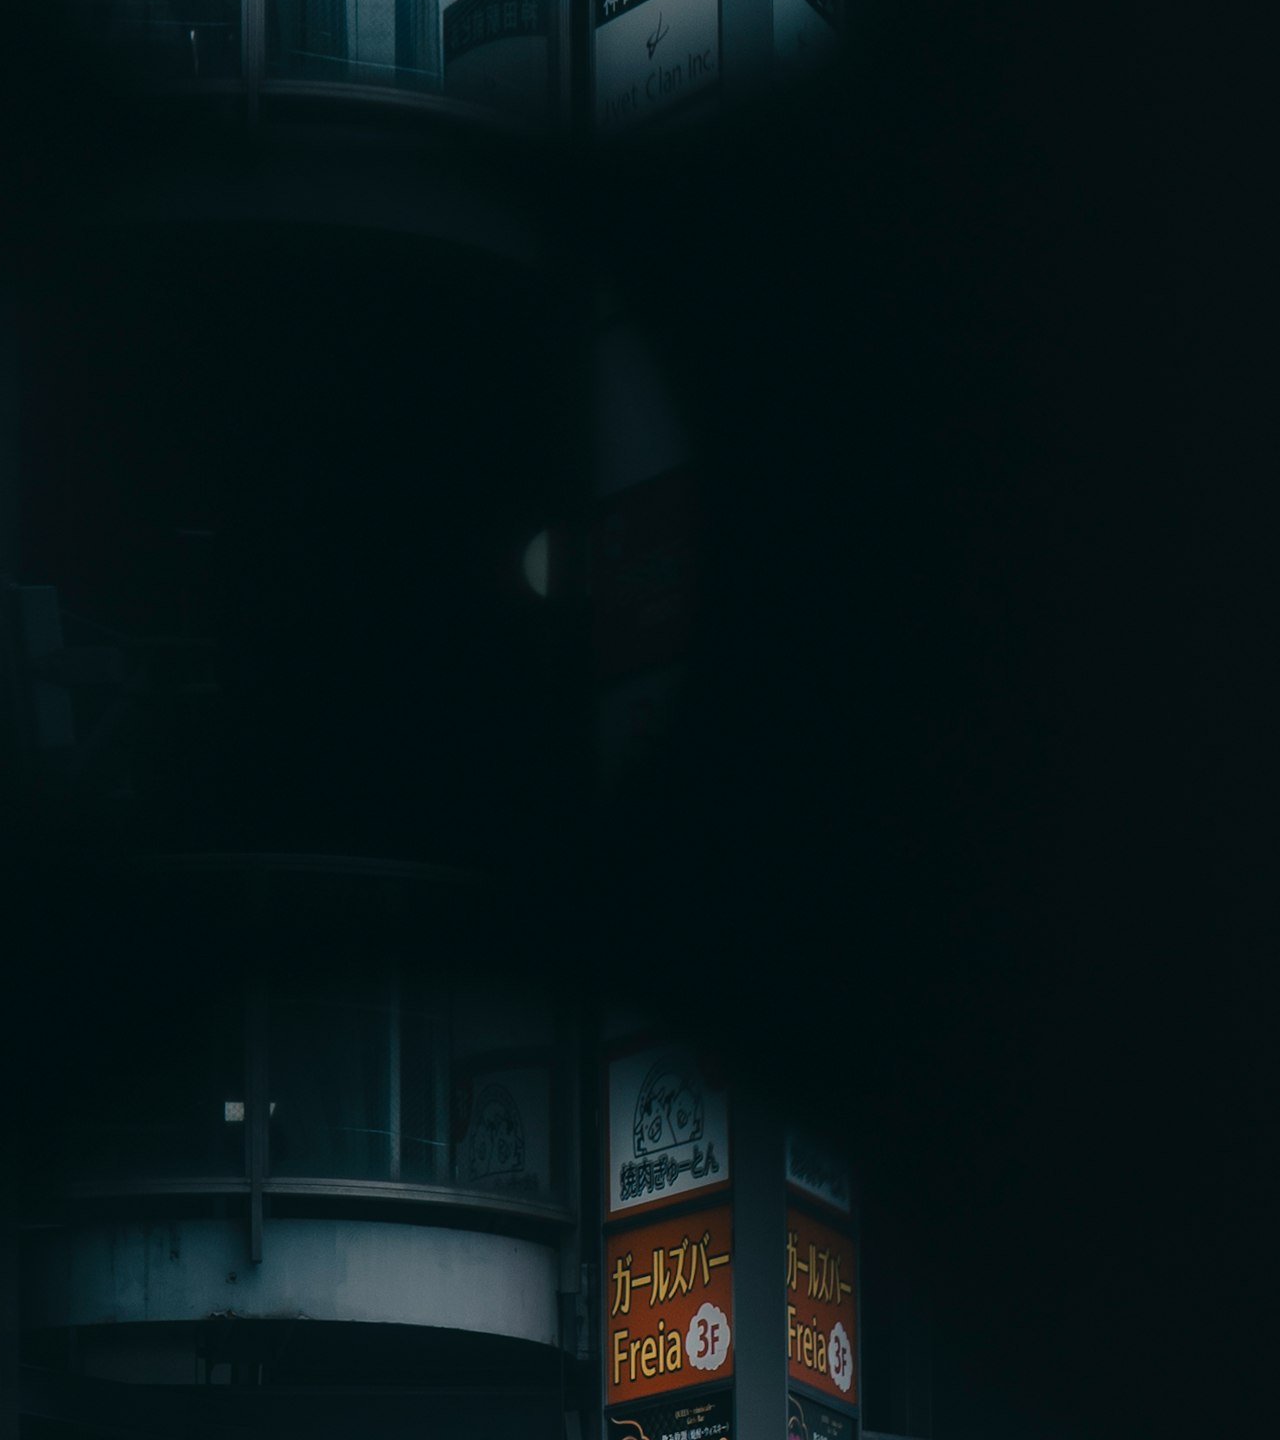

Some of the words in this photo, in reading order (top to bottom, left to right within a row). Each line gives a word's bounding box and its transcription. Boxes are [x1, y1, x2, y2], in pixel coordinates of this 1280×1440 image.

[619, 1140, 721, 1202] 焼肉ぎゅーとん
[610, 1229, 731, 1319] ガールズバー
[786, 1231, 853, 1306] ガールズバー
[612, 1319, 683, 1386] Freia
[696, 1318, 721, 1359] 3F
[786, 1303, 829, 1376] Freia
[833, 1335, 848, 1378] 3F
